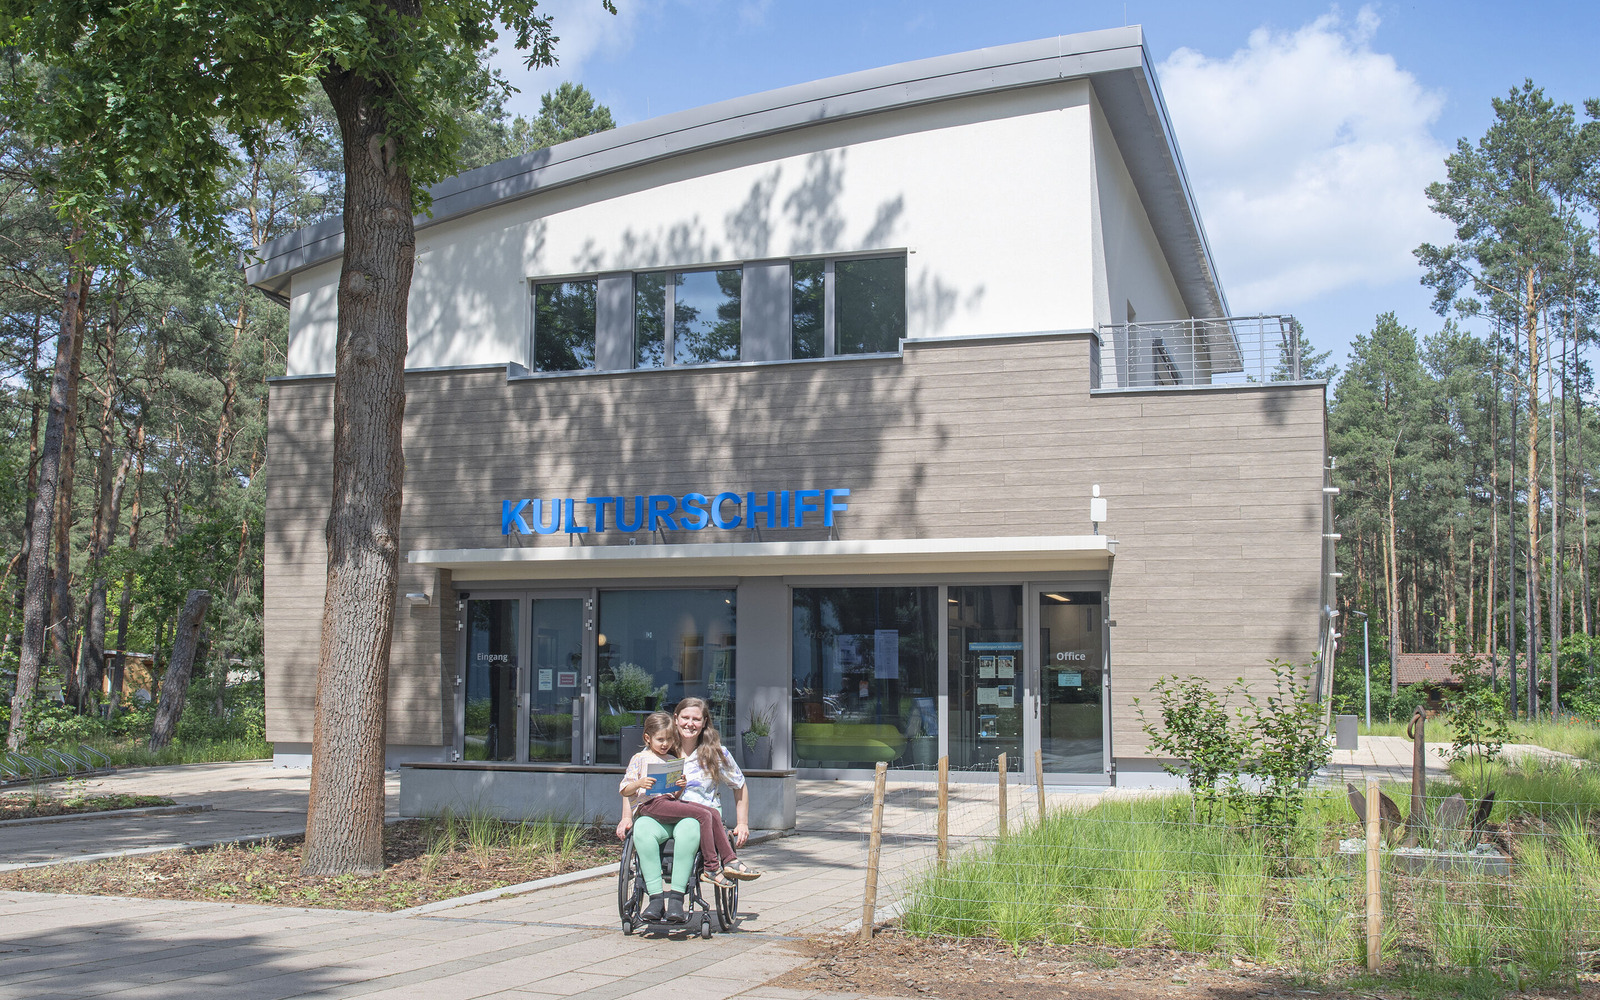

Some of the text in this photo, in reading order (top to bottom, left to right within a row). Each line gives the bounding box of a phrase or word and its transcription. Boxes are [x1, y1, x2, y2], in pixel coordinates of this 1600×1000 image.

[502, 488, 850, 535] KULTURSCHIFF
[477, 649, 508, 663] Eingang
[1056, 651, 1086, 661] Office
